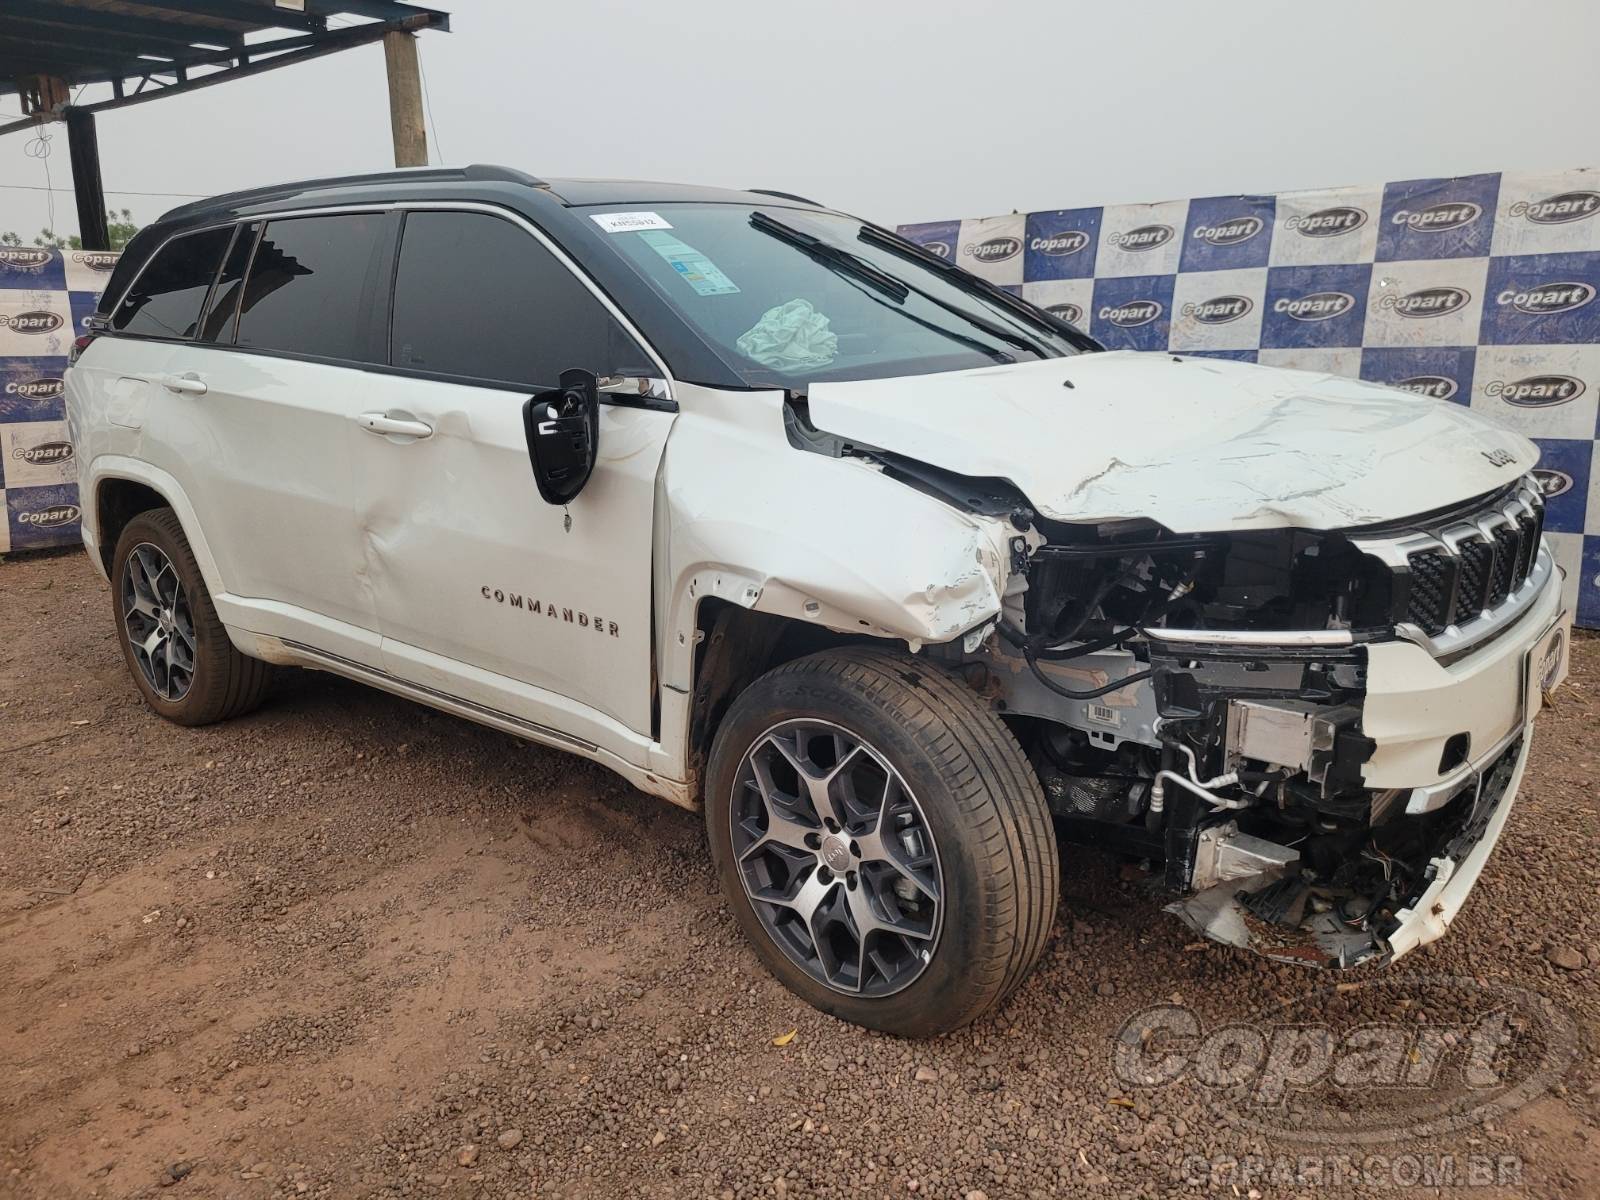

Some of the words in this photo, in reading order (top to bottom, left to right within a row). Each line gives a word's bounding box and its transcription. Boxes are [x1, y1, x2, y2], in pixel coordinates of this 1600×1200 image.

[1392, 205, 1469, 227] Copart
[1509, 195, 1597, 221] Copart
[1193, 221, 1254, 240] Copart
[1284, 211, 1356, 231] Copart
[1031, 234, 1082, 250] Copart
[1107, 226, 1163, 246] Copart
[0, 250, 44, 260] opart
[964, 241, 1014, 256] Copart
[72, 253, 119, 264] Copar
[1274, 297, 1345, 316] Copart
[1379, 291, 1461, 312] Copart
[1497, 286, 1588, 308] Copart
[1099, 303, 1157, 322] Copart
[1181, 300, 1242, 318] Copart
[5, 379, 63, 394] Copart
[1484, 380, 1576, 399] Copart
[12, 446, 69, 460] Copart
[18, 508, 74, 523] Copart
[481, 586, 620, 637] COMMANDER
